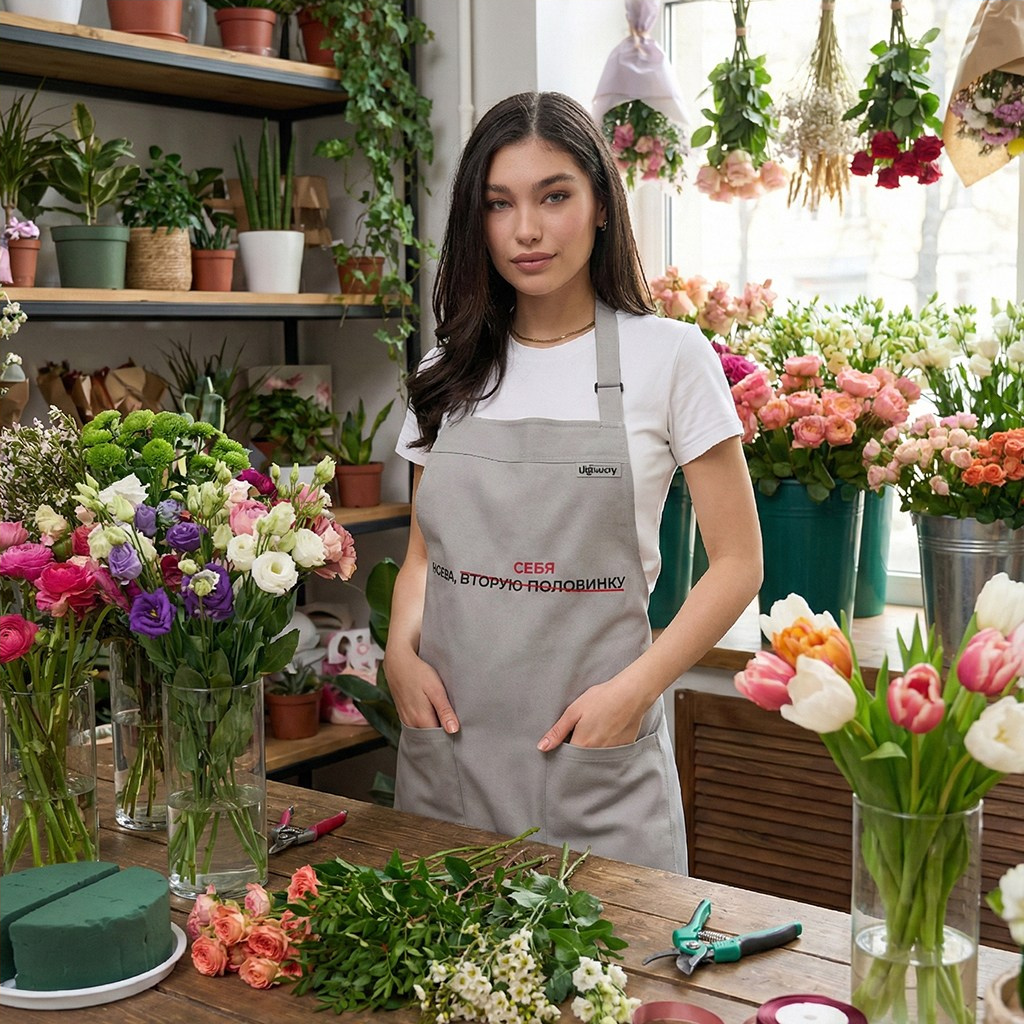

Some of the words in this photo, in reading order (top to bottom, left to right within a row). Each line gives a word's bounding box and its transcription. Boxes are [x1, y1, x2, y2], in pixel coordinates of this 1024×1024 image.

[513, 561, 555, 574] СЕБЯ
[460, 572, 523, 592] ВТОРУЮ
[528, 576, 626, 593] ПОЛОВИНКУ
